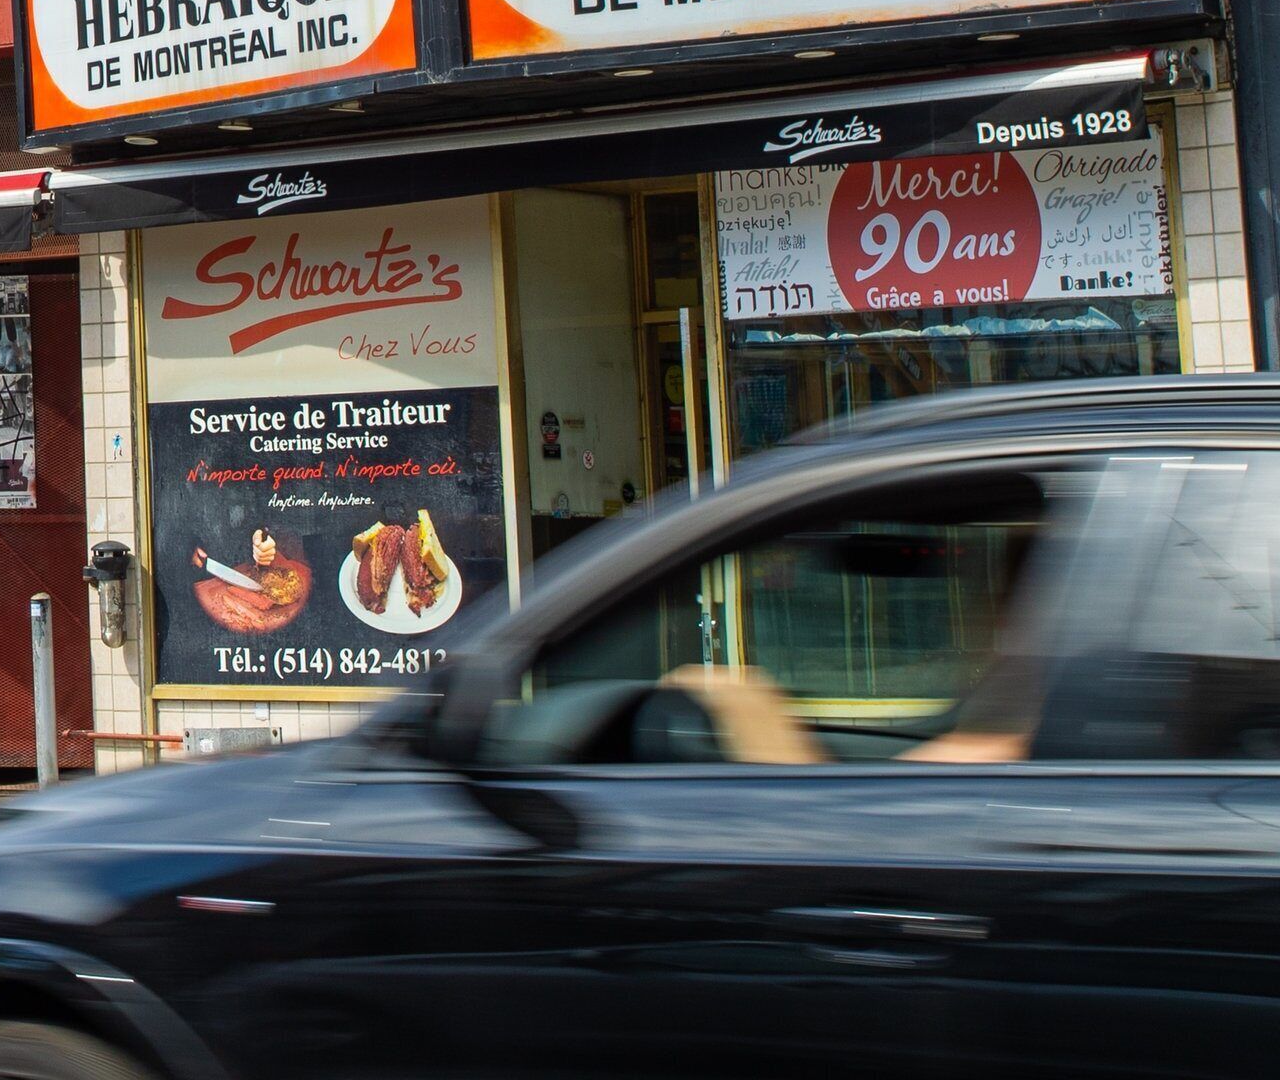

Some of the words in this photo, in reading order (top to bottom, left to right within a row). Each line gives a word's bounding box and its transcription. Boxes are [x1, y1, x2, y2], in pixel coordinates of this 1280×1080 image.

[86, 56, 123, 93] DE
[132, 27, 288, 85] MONTRÉAL
[298, 14, 360, 52] INC.
[763, 114, 882, 163] Schwartz's
[977, 116, 1065, 147] Depuis
[1071, 109, 1132, 137] 1928
[236, 171, 328, 216] Schwartz's
[857, 152, 1001, 211] Merci!
[1044, 183, 1127, 225] Grazie!
[855, 210, 951, 282] 90
[952, 229, 1016, 260] ans
[734, 255, 800, 282] Aitäh!
[1060, 270, 1133, 291] Danke!
[160, 227, 464, 355] Schwartz's
[866, 286, 922, 310] Grâce
[956, 279, 1009, 304] vous!
[338, 335, 399, 361] Chez
[410, 324, 478, 358] Vous
[190, 405, 285, 435] Service
[293, 403, 325, 429] de
[332, 399, 451, 428] Traiteur
[249, 434, 323, 455] Catering
[326, 431, 388, 451] Service
[186, 460, 267, 488] N'importe
[273, 461, 329, 489] quand.
[335, 454, 421, 483] N'importe
[268, 492, 315, 511] Anytime.
[317, 491, 376, 509] Anywhere.
[213, 646, 266, 673] Tél.:
[273, 647, 333, 680] (514)
